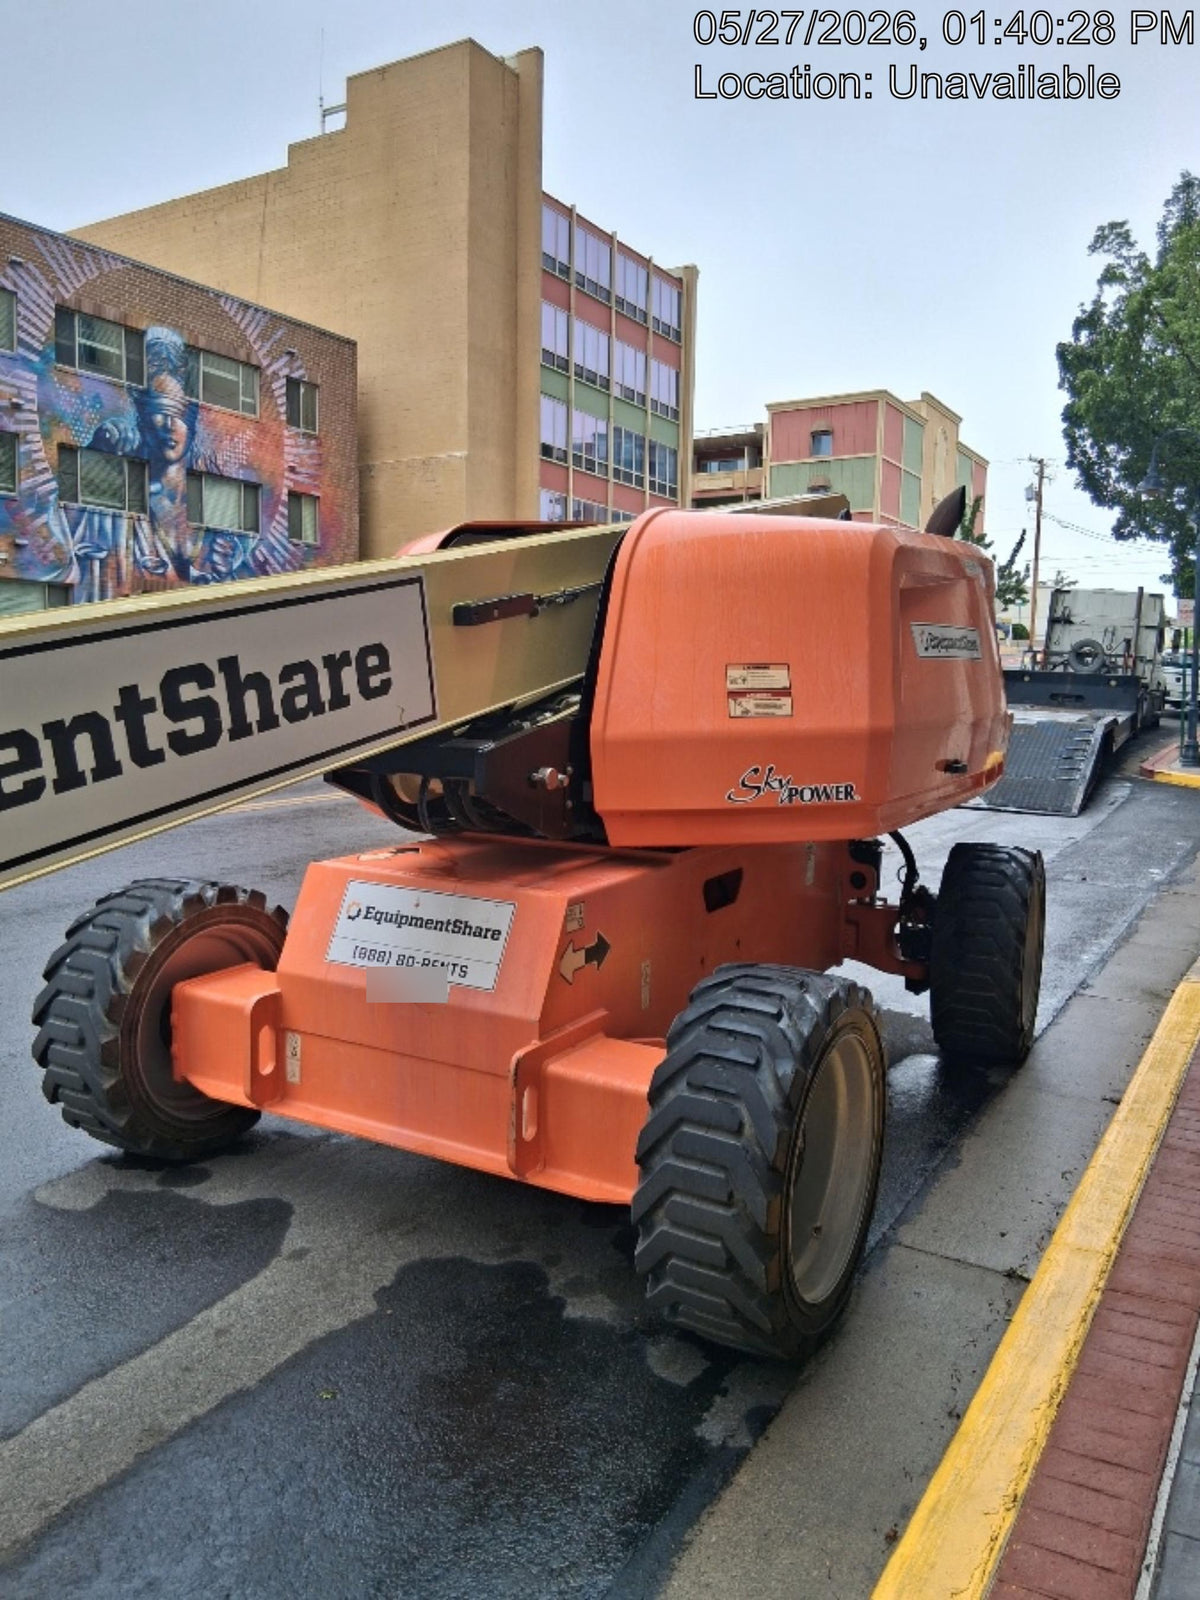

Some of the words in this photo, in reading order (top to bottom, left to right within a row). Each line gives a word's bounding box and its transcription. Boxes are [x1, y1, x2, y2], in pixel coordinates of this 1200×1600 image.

[0, 642, 392, 812] entShare
[786, 783, 857, 804] POWER
[363, 906, 502, 941] EquipmentShare
[352, 945, 392, 966] (888)
